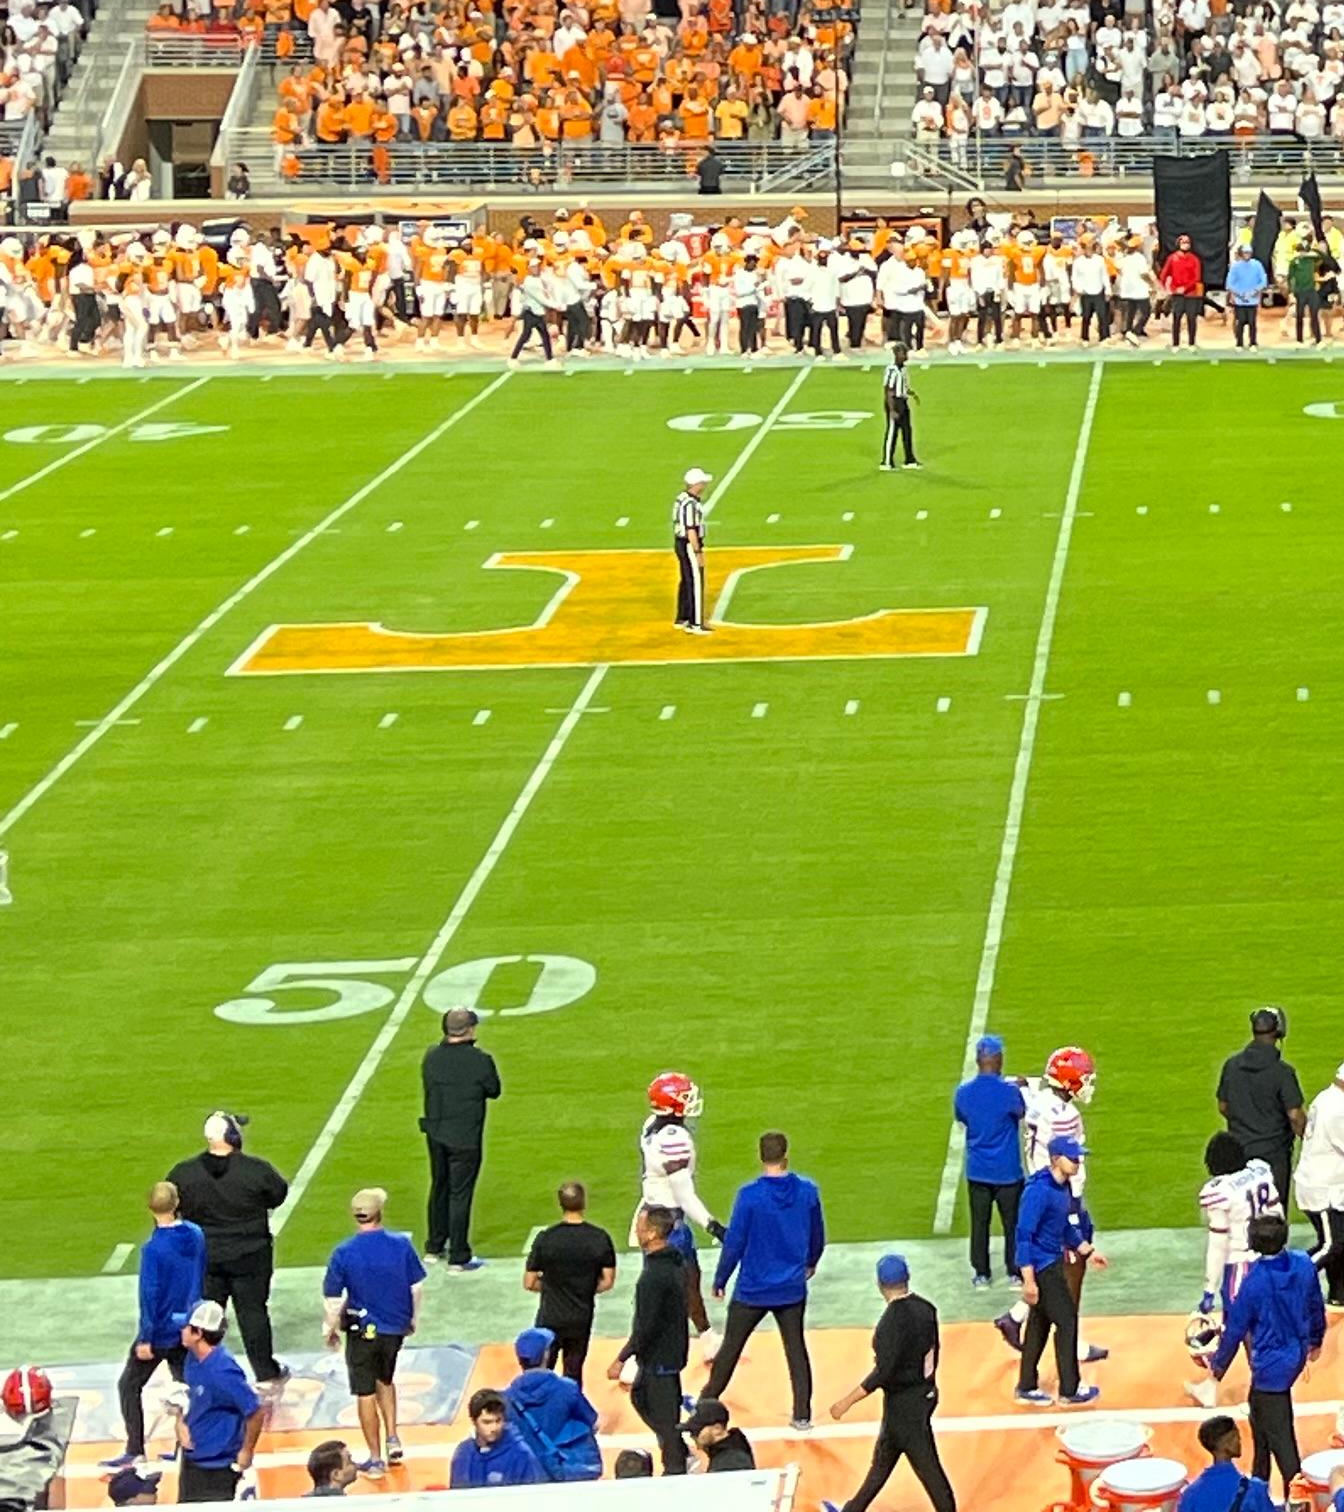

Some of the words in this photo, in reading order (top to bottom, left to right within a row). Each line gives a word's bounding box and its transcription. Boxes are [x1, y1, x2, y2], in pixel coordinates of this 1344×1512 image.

[2, 422, 232, 444] 40
[666, 410, 874, 431] 50
[225, 544, 990, 676] T
[213, 954, 597, 1025] 50
